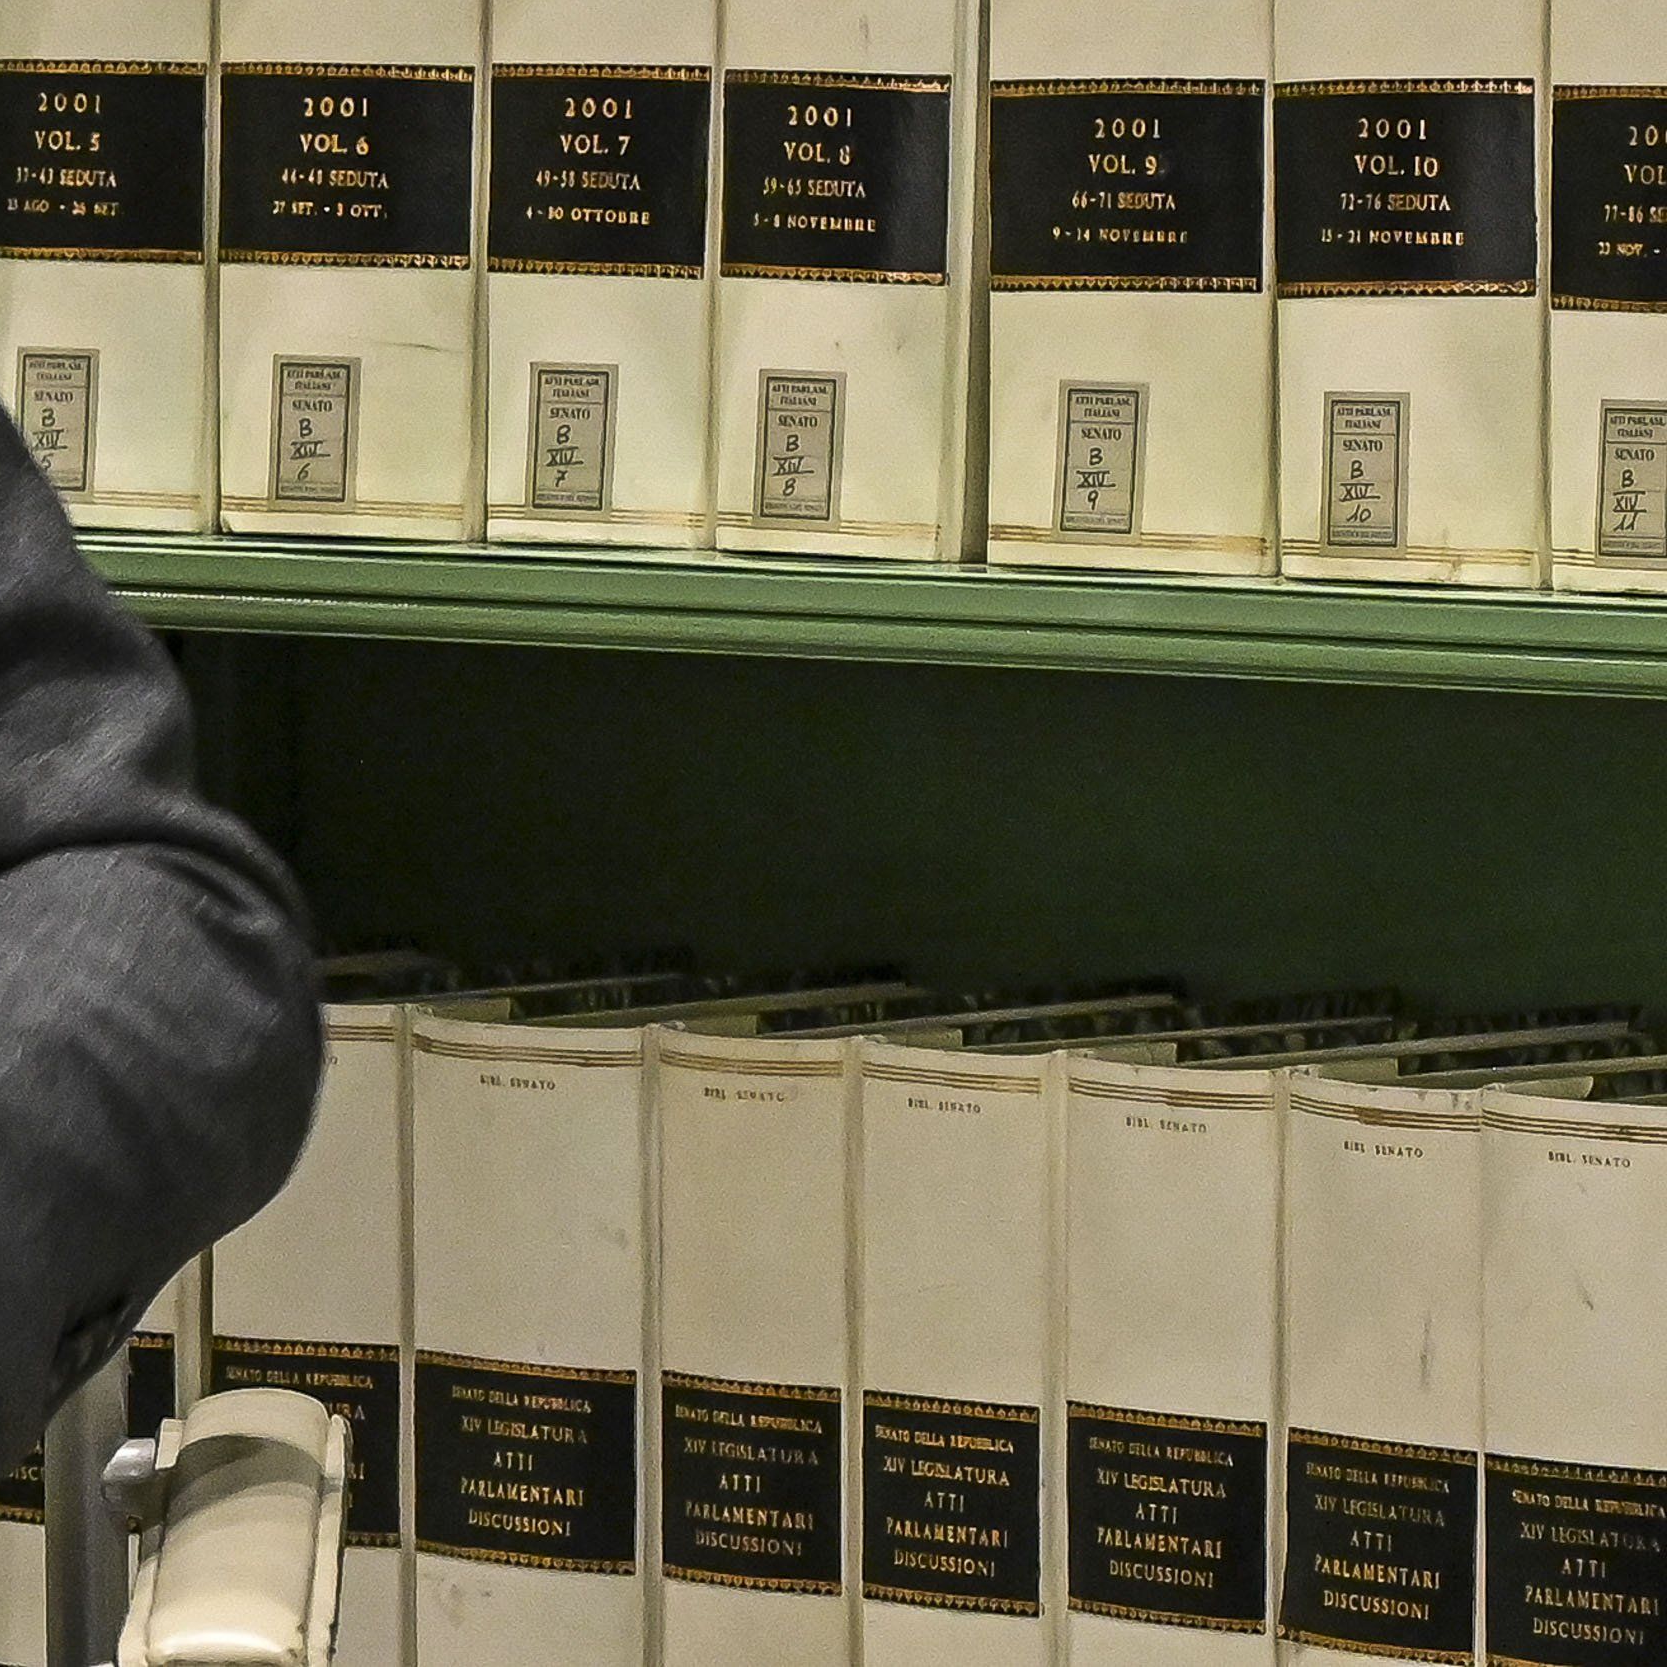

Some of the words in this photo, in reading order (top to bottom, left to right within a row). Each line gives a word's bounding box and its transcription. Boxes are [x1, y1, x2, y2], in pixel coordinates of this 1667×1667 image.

[39, 92, 100, 113] 2001
[304, 97, 367, 117] 2001
[565, 98, 631, 119] 2001
[788, 106, 851, 126] 2001
[1095, 118, 1160, 138] 2001
[1359, 118, 1426, 139] 2001
[35, 131, 80, 150] VOL.
[90, 133, 100, 151] 5
[356, 137, 369, 155] 6
[560, 134, 608, 154] VOL.
[619, 136, 630, 155] 7
[784, 142, 830, 163] VOL.
[1089, 154, 1135, 174] VOL.
[1146, 156, 1157, 175] 9
[1354, 155, 1404, 175] VOL.
[1415, 156, 1438, 177] 10
[1343, 439, 1382, 451] SENATO
[461, 1478, 583, 1506] PARLAMENTARI
[719, 1474, 760, 1492] ATTI
[925, 1491, 964, 1512] ATTI
[469, 1509, 570, 1536] DISCUSSIONI
[1136, 1503, 1177, 1524] ATTI
[1351, 1530, 1391, 1552] ATTI
[894, 1550, 994, 1577] DISCUSSIONI
[1110, 1560, 1213, 1588] DISCUSSIONI
[1315, 1554, 1439, 1589] PARLAMENTARI
[1324, 1590, 1428, 1620] DISCUSSIONI
